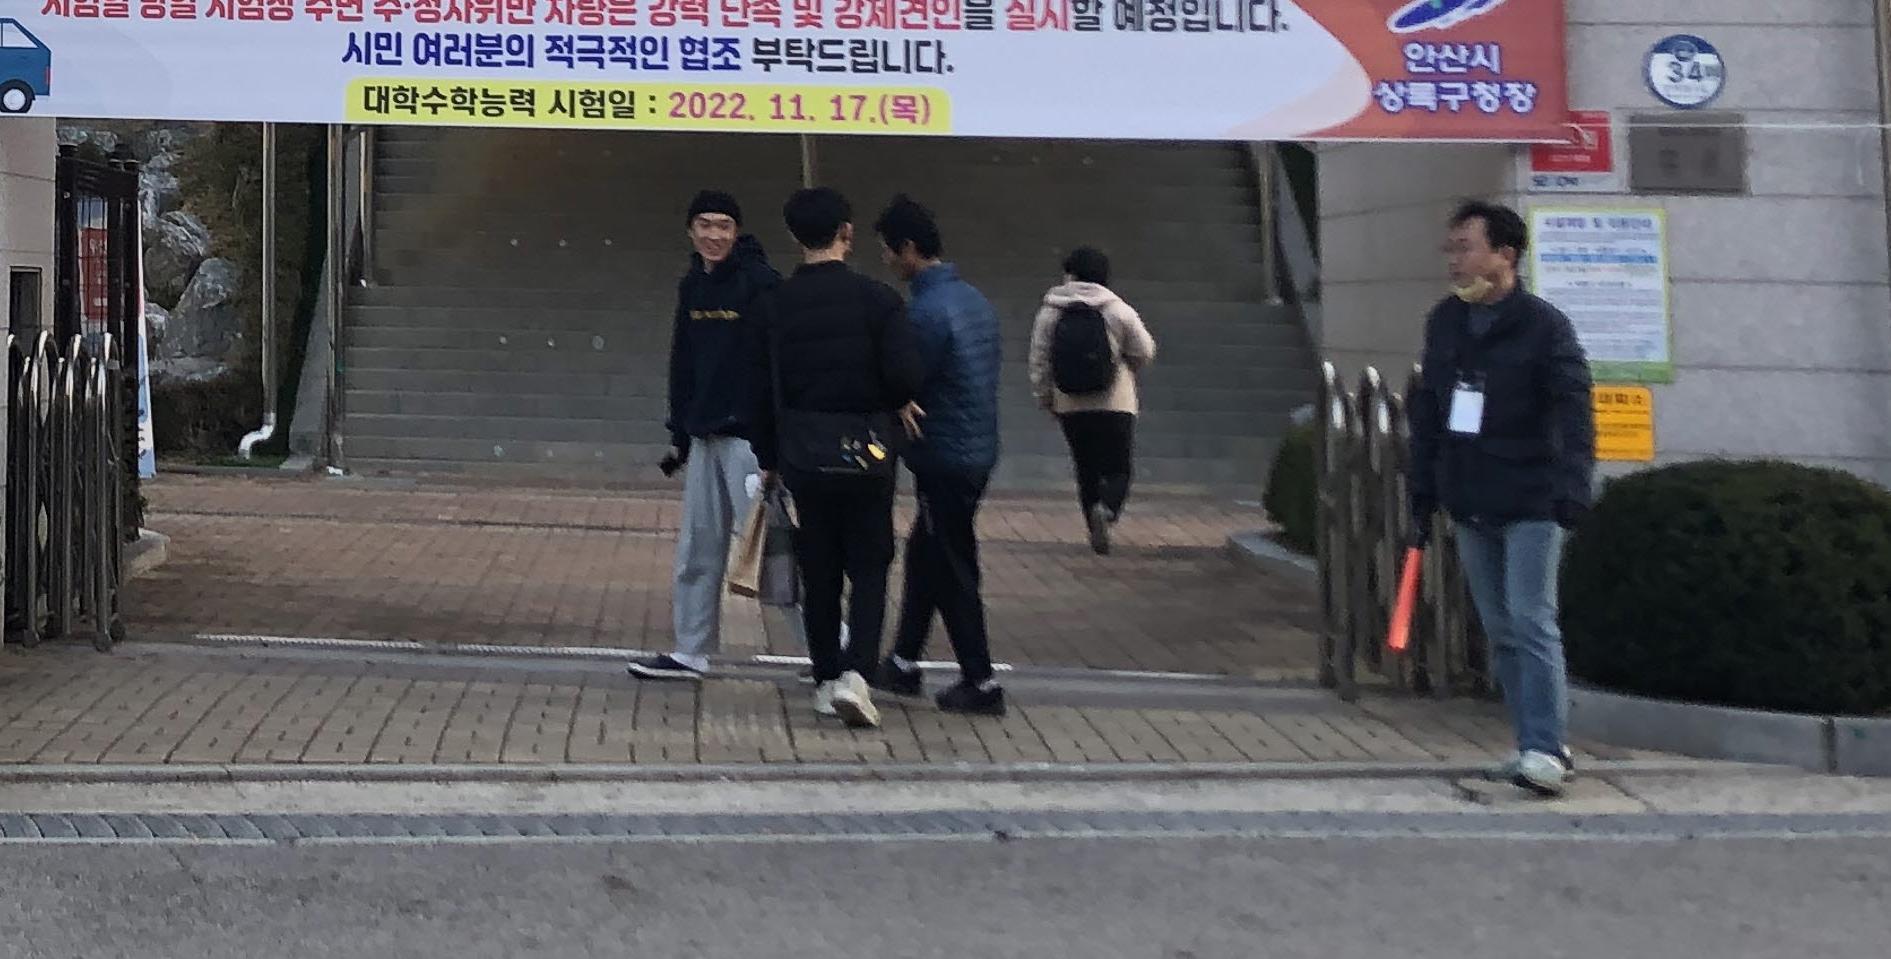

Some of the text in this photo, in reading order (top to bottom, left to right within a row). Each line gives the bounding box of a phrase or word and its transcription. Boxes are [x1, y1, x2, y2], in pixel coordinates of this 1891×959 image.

[341, 31, 955, 74] 시민 여러분의 적극적인 협조 부탁드립니다.
[1403, 42, 1502, 75] 안산시
[362, 85, 536, 118] 대학수학능력
[547, 87, 637, 119] 시험일
[668, 91, 756, 121] 2022.
[768, 93, 815, 122] 11.
[829, 93, 931, 126] 17.(목)
[1372, 80, 1537, 114] 상록구청장
